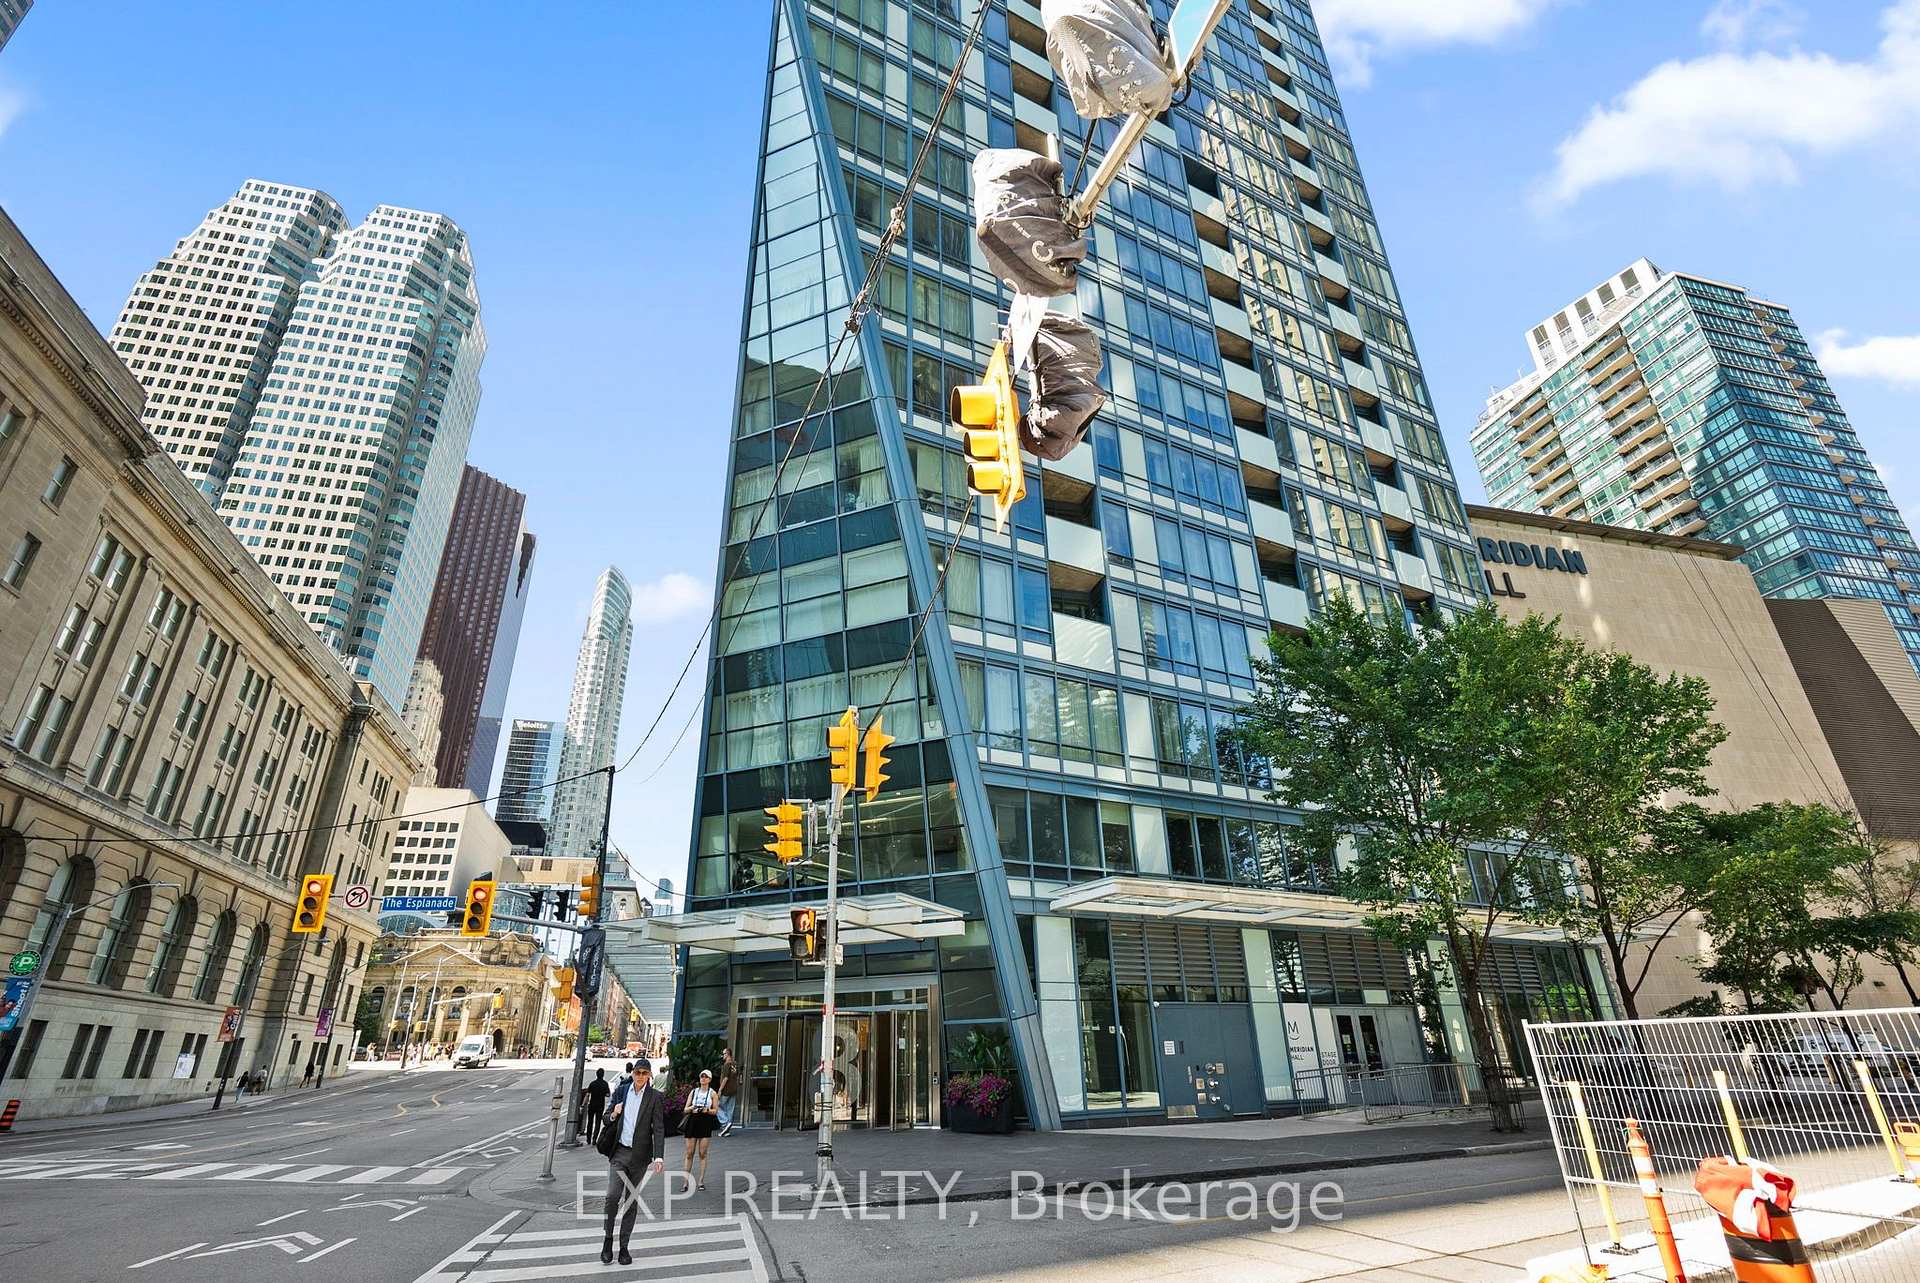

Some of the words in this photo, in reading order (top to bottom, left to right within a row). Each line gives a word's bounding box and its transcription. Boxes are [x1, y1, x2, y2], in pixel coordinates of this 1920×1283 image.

[1477, 537, 1588, 575] RIDIAN
[1485, 570, 1526, 598] LL
[386, 898, 402, 908] The
[406, 898, 454, 910] Esplanade
[18, 956, 33, 968] P
[11, 989, 27, 1017] Shoot
